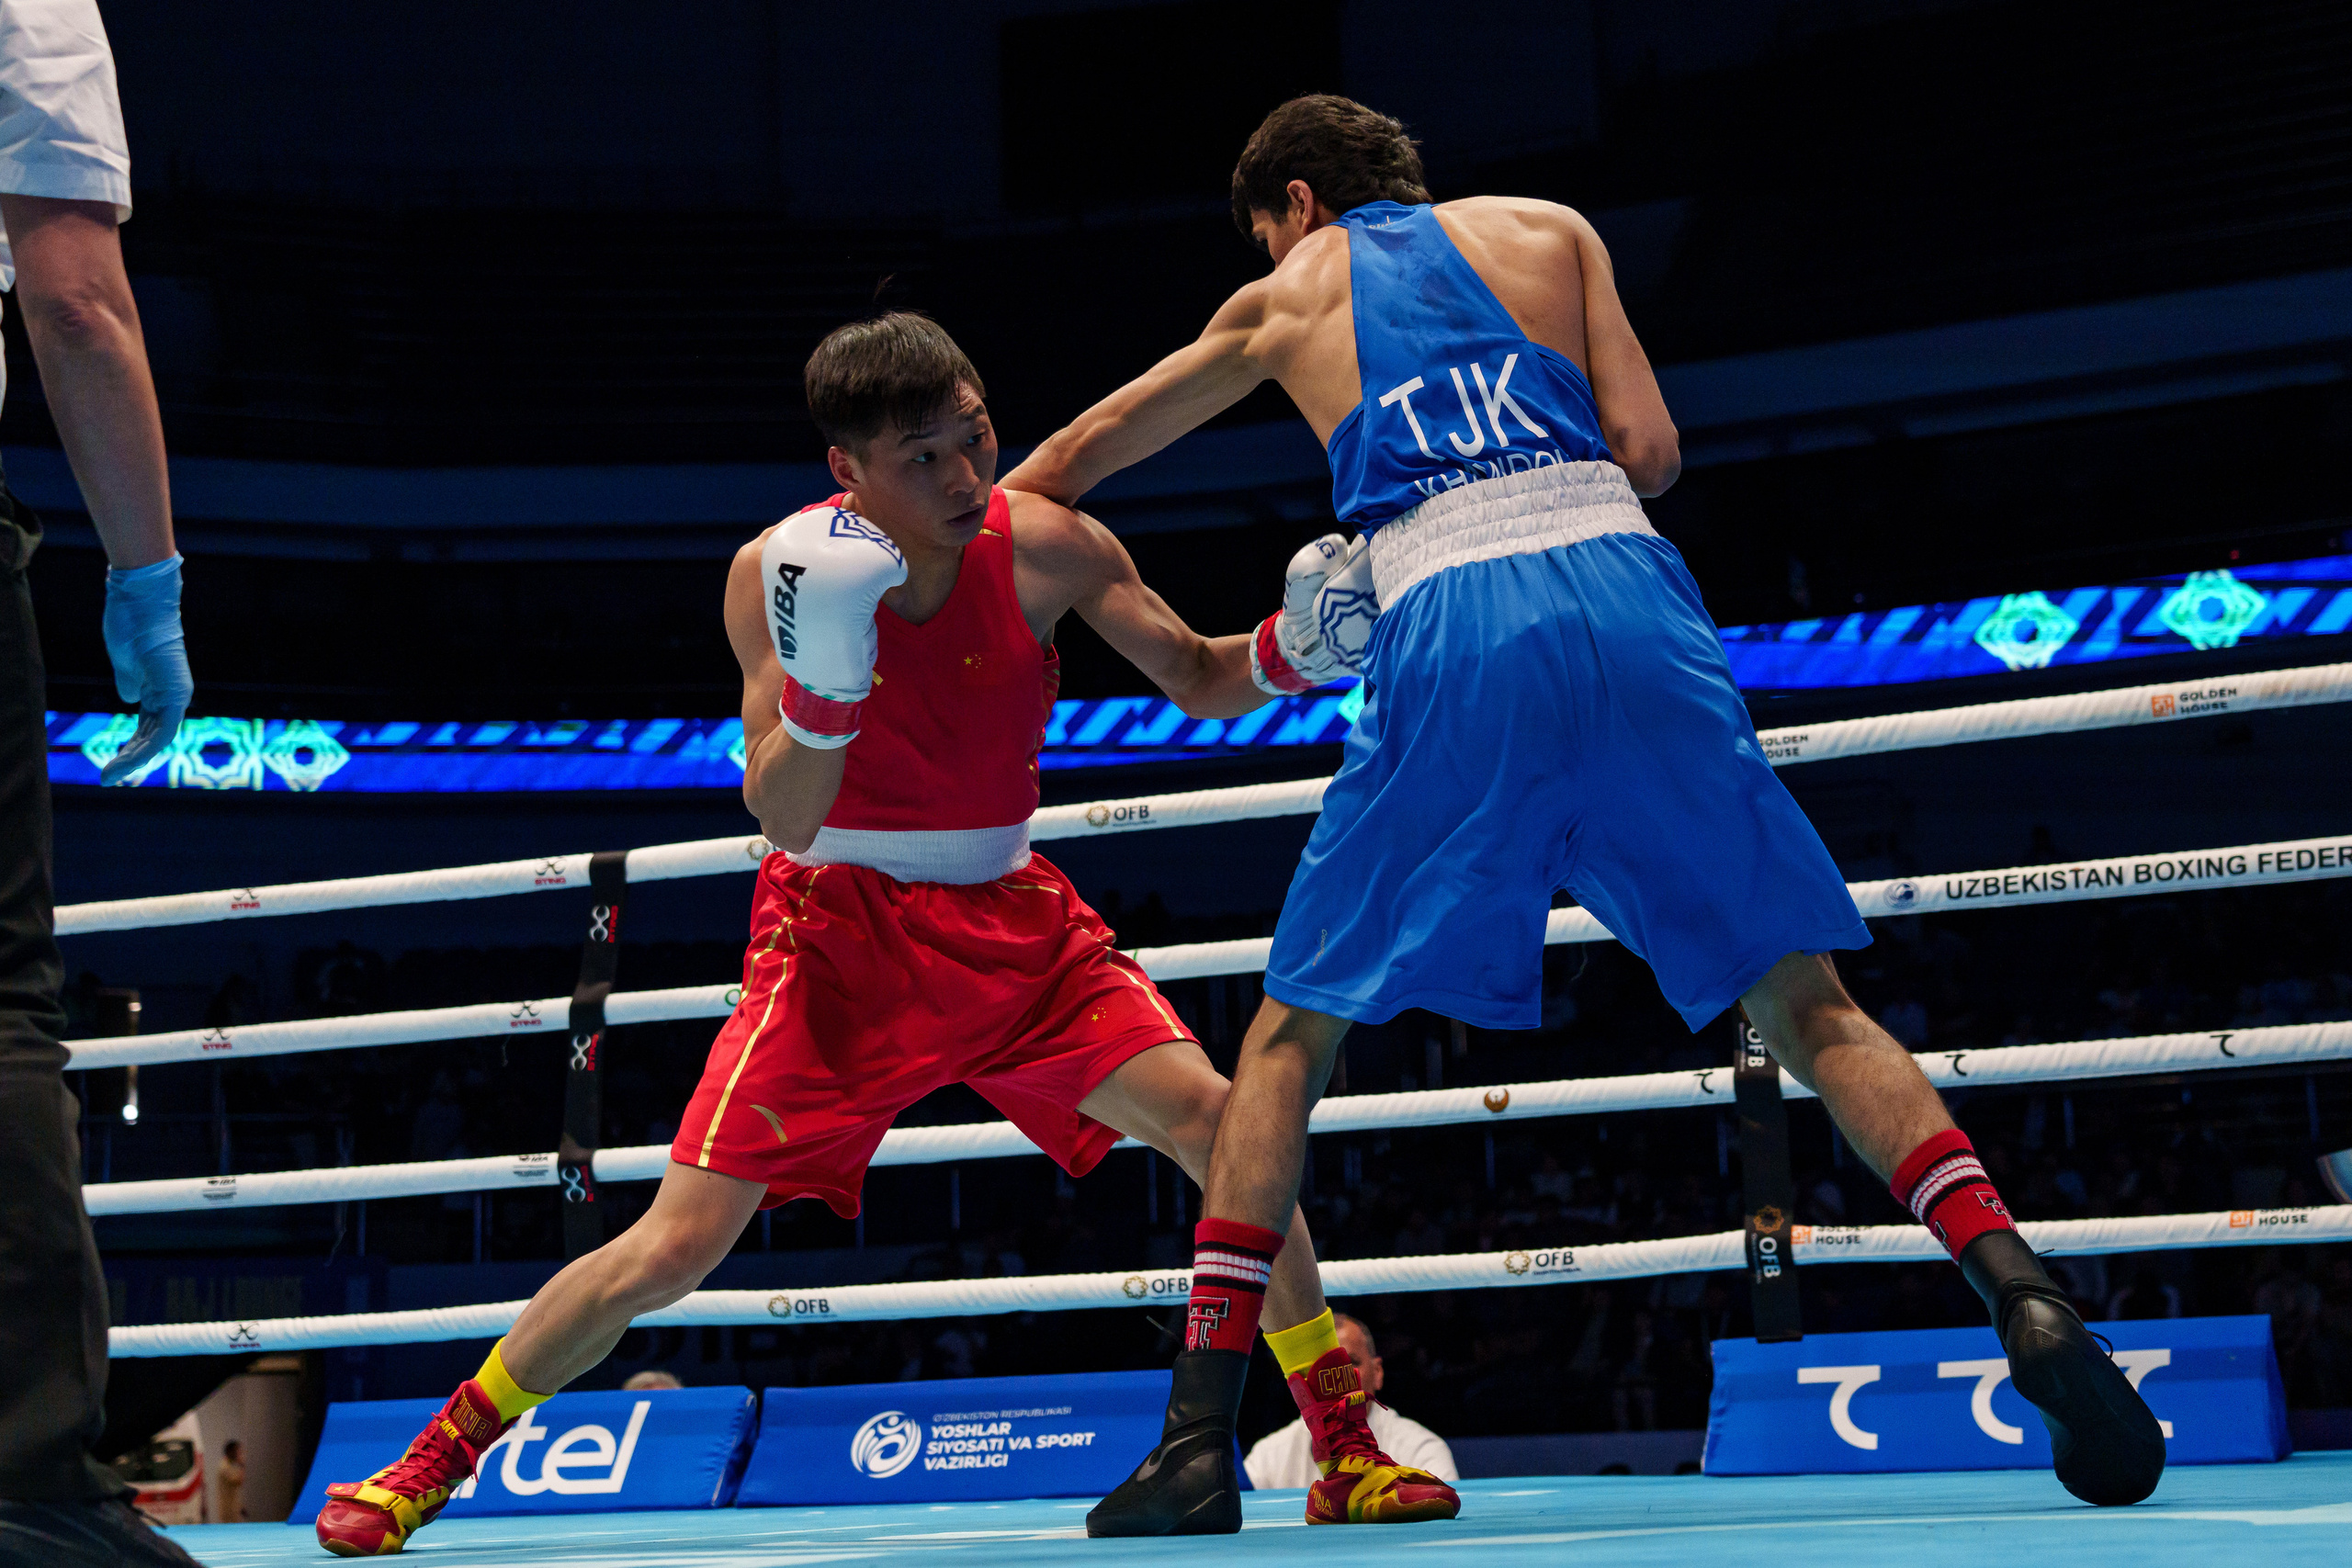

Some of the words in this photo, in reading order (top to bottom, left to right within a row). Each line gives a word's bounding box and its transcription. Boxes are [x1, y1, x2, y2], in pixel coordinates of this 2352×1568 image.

[1379, 354, 1549, 462] TJK
[775, 562, 808, 631] IBA
[2179, 688, 2236, 703] GOLDEN
[2180, 702, 2228, 714] HOUSE
[1765, 747, 1800, 759] OUSE
[1114, 805, 1149, 821] OFB
[1946, 865, 2123, 900] UZBEKISTAN
[2133, 855, 2247, 885] BOXING
[2257, 846, 2352, 874] FEDER
[2258, 1213, 2309, 1226] HOUSE
[1815, 1235, 1861, 1245] HOUSE
[1535, 1250, 1574, 1268] OFB
[1758, 1236, 1781, 1278] OFB
[1151, 1277, 1189, 1293] OFB
[795, 1299, 830, 1314] OFB
[1318, 1363, 1359, 1395] CHIN
[931, 1422, 1012, 1438] YOSHLAR
[926, 1438, 1004, 1455] SIYOSATI
[1008, 1436, 1032, 1450] VA
[1035, 1432, 1095, 1450] SPORT
[923, 1453, 1009, 1471] VAZIRLIGI
